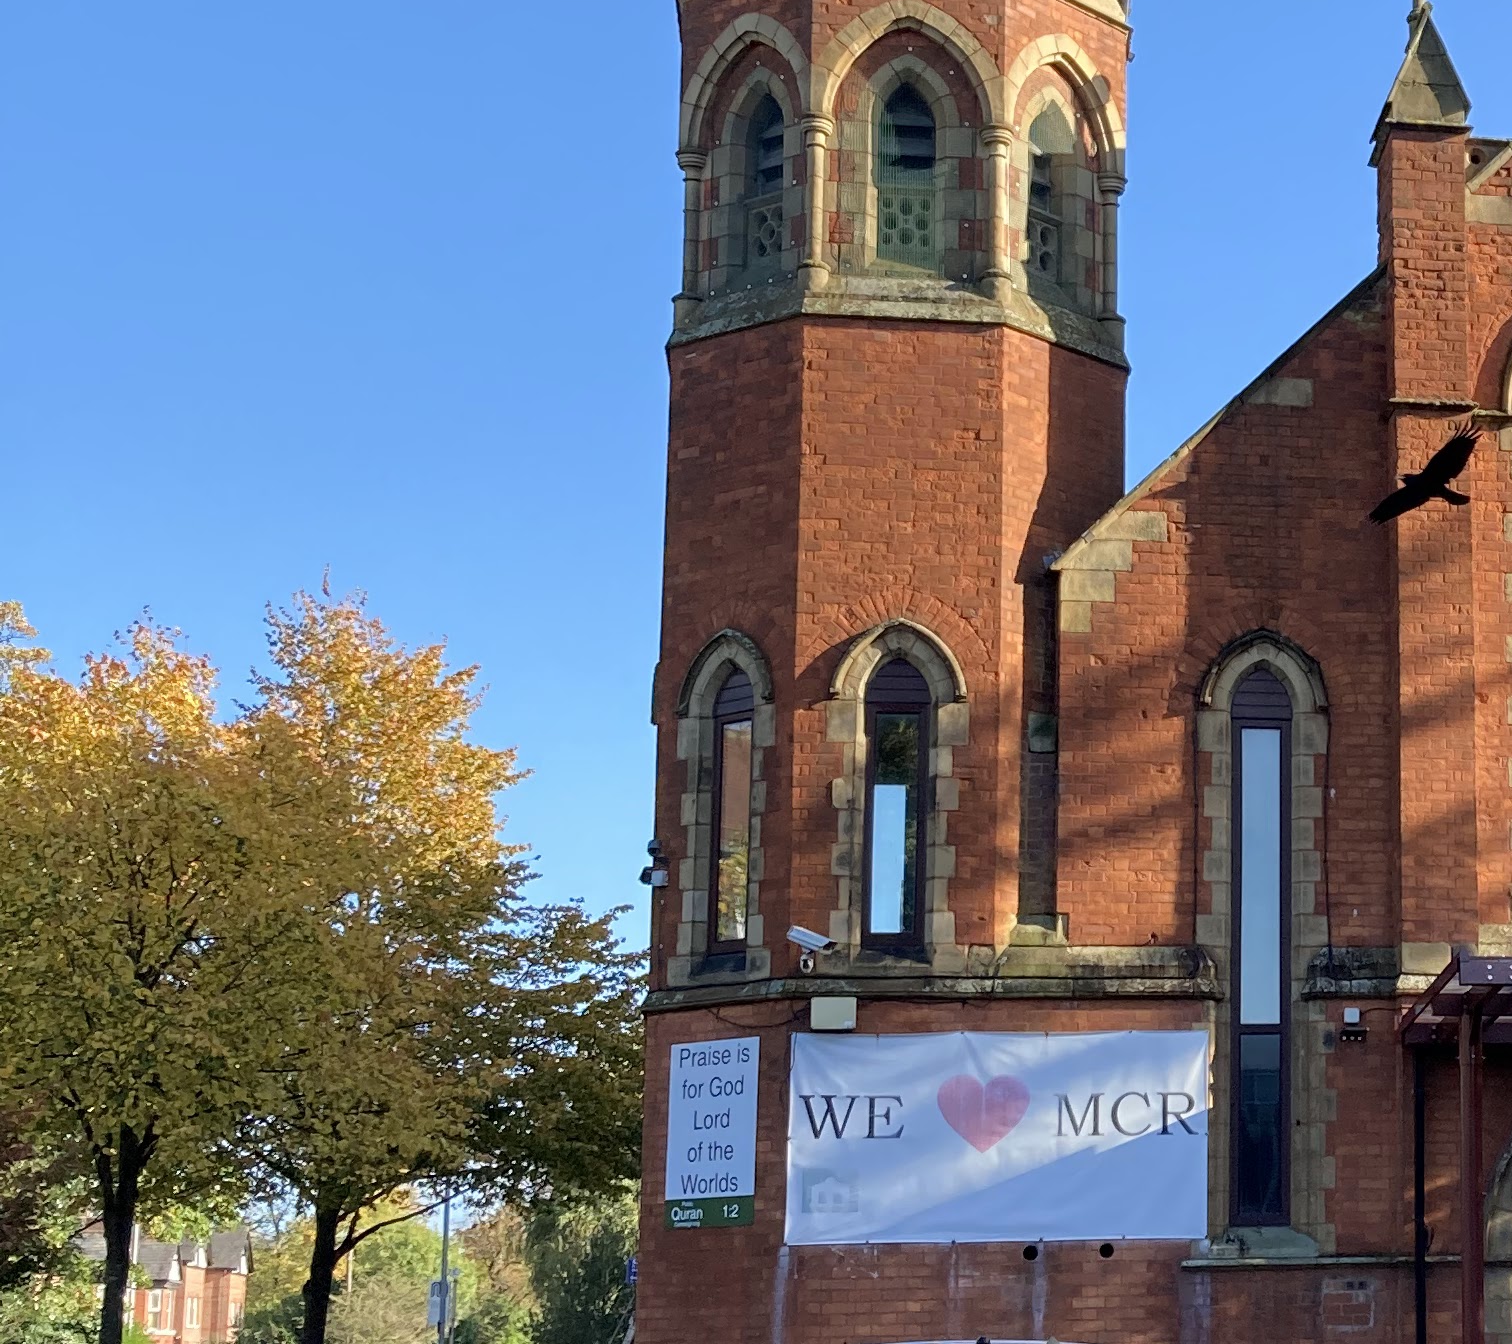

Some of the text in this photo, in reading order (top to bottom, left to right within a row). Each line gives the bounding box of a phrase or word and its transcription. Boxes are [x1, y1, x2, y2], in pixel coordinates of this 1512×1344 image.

[680, 1043, 750, 1068] Praise is
[682, 1074, 744, 1099] for God
[694, 1107, 730, 1130] Lord
[799, 1091, 1199, 1139] WE MCR
[687, 1141, 734, 1163] of the
[681, 1172, 738, 1194] Worlds
[671, 1203, 739, 1221] Quran 1:2
